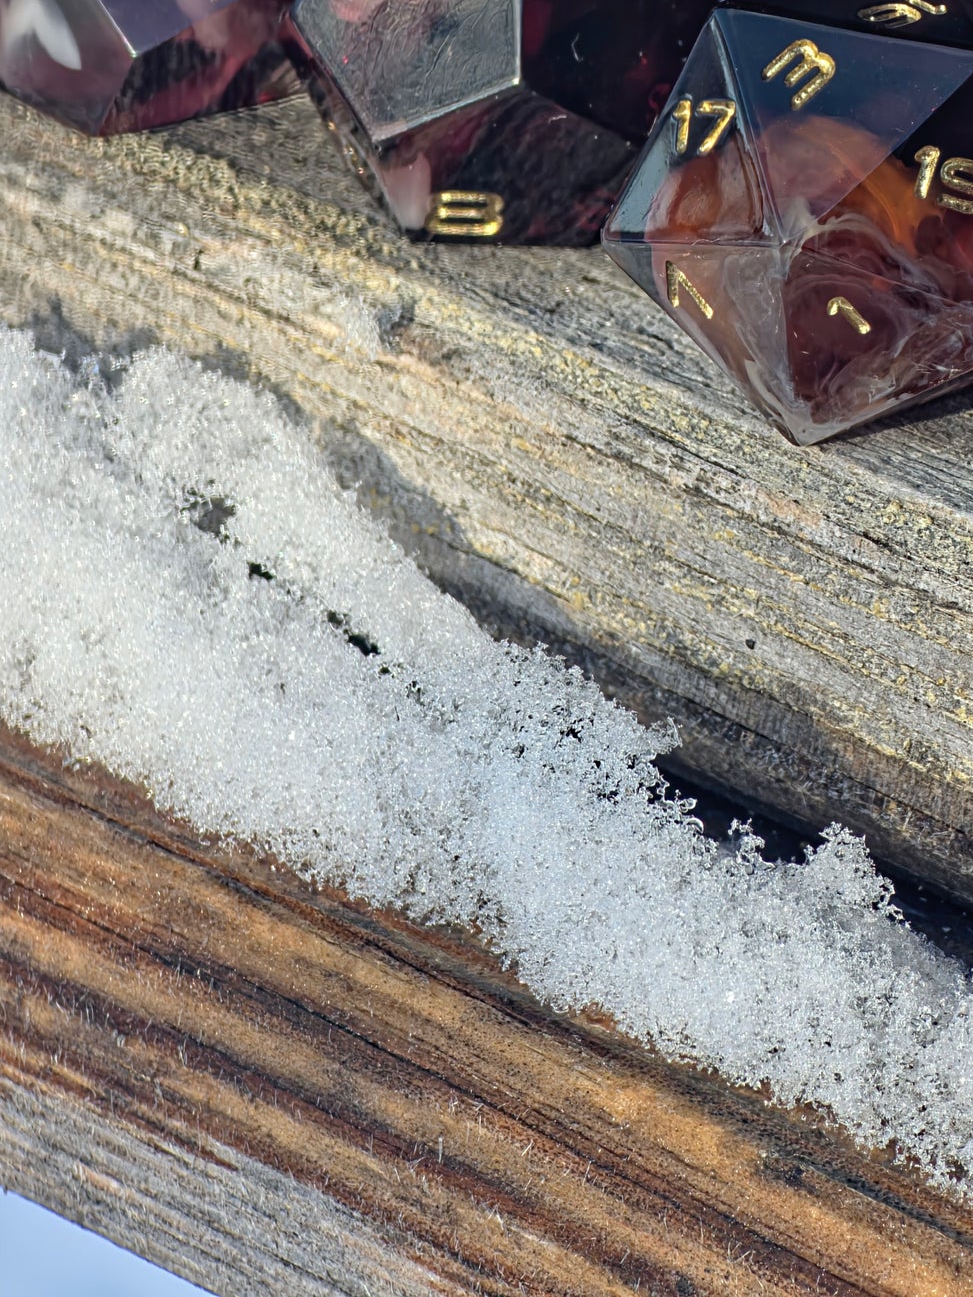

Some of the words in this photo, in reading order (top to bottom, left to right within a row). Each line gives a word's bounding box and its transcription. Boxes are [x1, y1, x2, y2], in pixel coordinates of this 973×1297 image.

[761, 38, 836, 110] 3
[670, 99, 737, 156] 17
[424, 189, 505, 236] 8
[826, 295, 872, 335] 1
